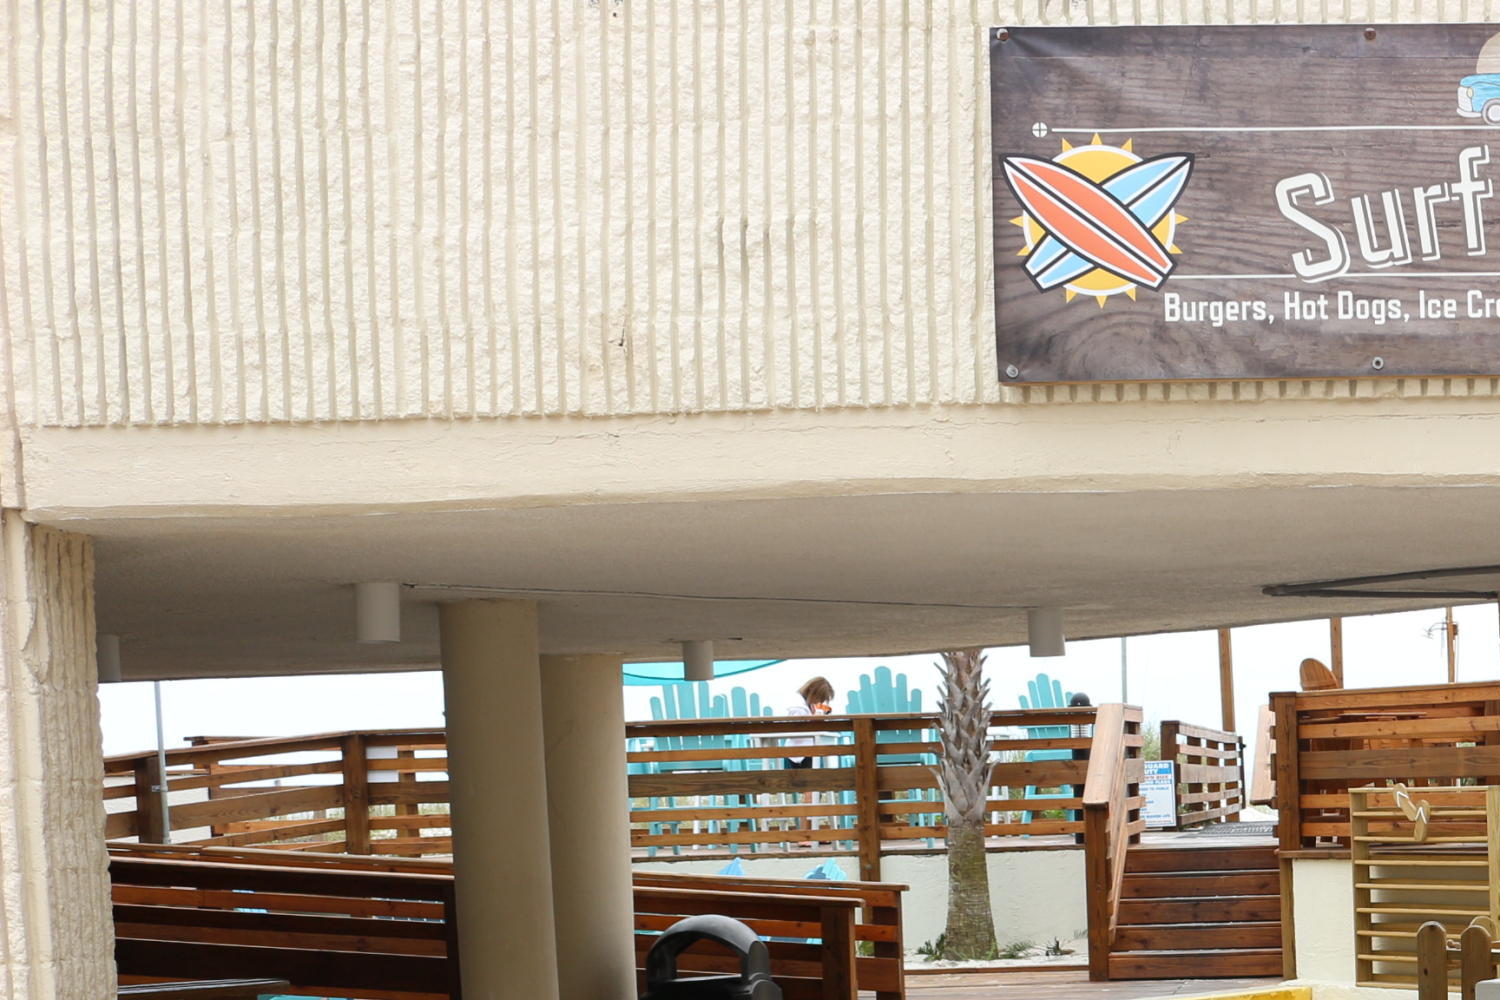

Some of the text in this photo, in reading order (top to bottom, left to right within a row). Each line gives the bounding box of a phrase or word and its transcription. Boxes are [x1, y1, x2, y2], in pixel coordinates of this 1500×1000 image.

[1275, 144, 1494, 283] Surf
[1163, 292, 1275, 328] Burgers,
[1284, 290, 1329, 321] Hot
[1337, 290, 1411, 325] Dogs,
[1419, 289, 1458, 320] Ice
